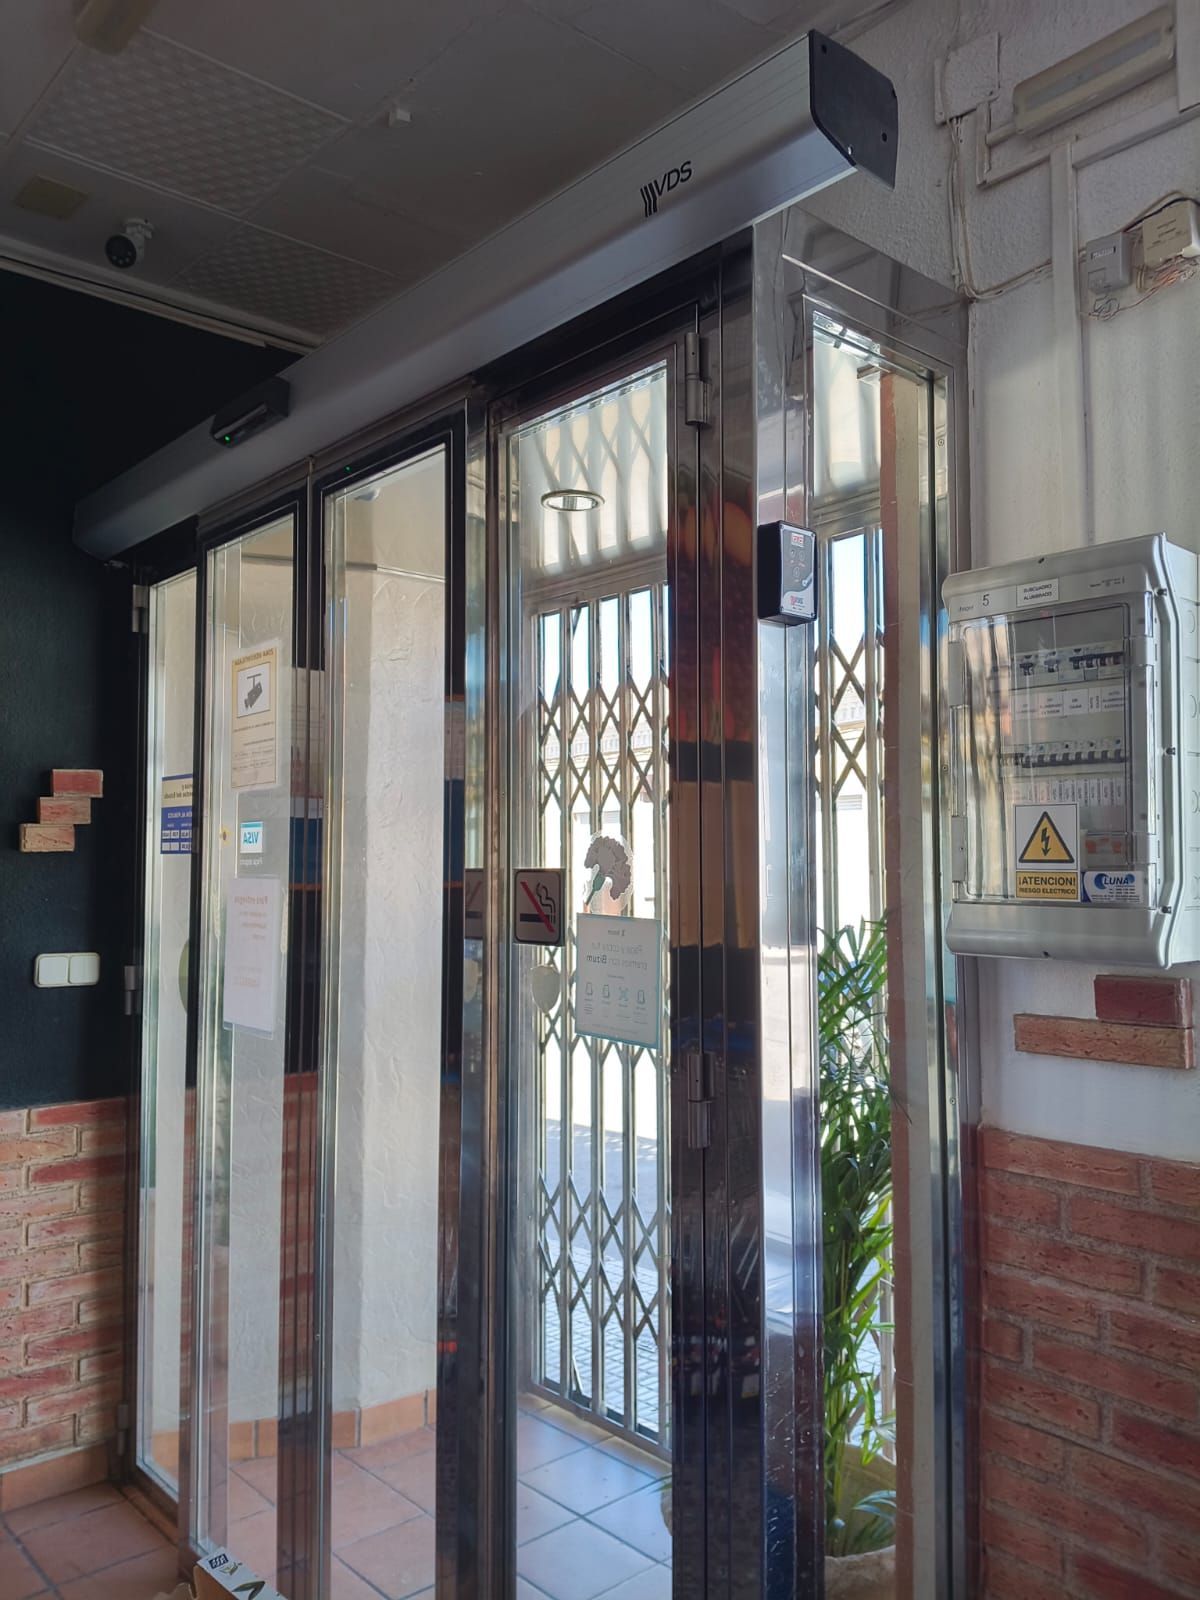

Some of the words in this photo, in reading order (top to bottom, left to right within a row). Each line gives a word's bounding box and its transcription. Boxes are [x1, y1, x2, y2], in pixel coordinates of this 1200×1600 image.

[653, 160, 692, 196] VDS
[982, 593, 990, 607] 5
[1019, 876, 1076, 886] ¡ATENCION!
[1104, 877, 1129, 886] LUNA
